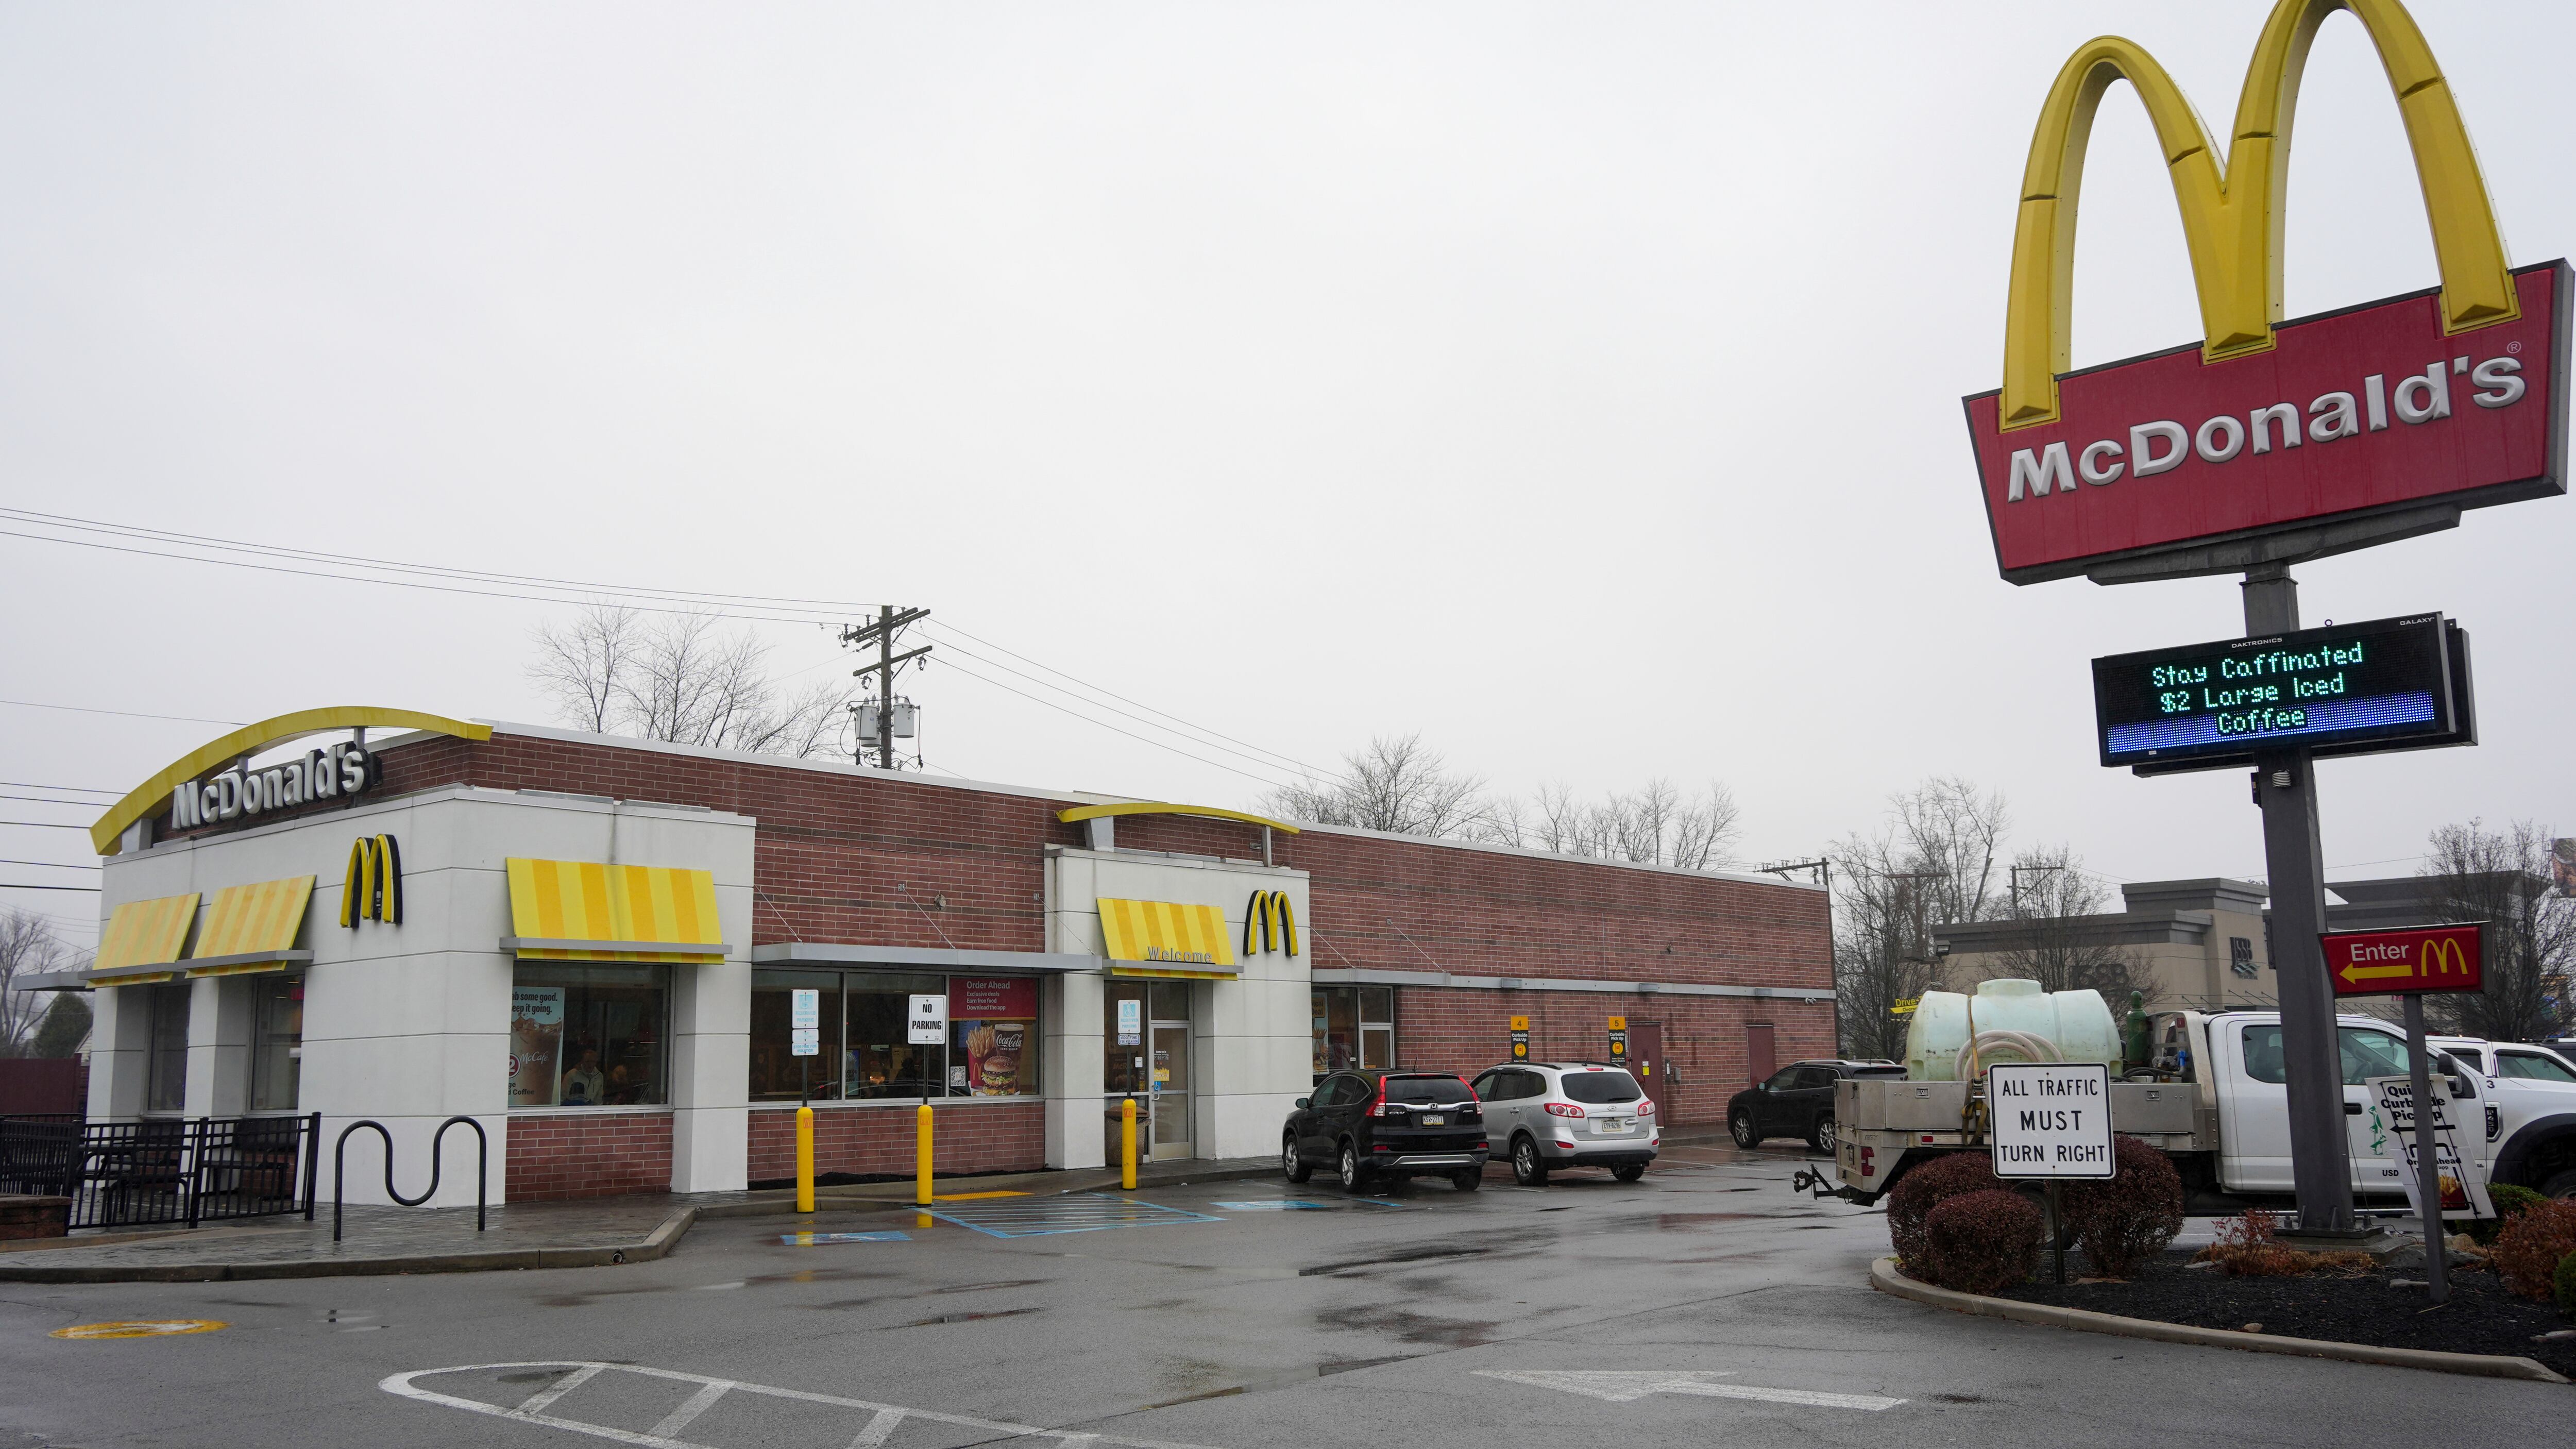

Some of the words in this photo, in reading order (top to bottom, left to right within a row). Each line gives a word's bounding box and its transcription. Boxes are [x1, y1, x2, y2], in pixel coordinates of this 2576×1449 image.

[2007, 356, 2526, 503] McDonald's
[2399, 617, 2433, 626] GALAXY
[2231, 637, 2283, 648] DAKTRONICS
[2153, 666, 2207, 687] Stay
[2222, 641, 2363, 679] Caffinated
[2160, 690, 2191, 713] $2
[2204, 685, 2279, 708] Large
[2293, 671, 2345, 698] Iced
[2218, 707, 2306, 733] Coffee
[172, 743, 366, 830] McDonald's
[1147, 946, 1213, 964] Welcome
[2350, 942, 2410, 962] Enter
[988, 981, 1010, 989] Ahead
[539, 992, 558, 1003] good.
[512, 1005, 524, 1014] eep
[526, 1004, 531, 1012] it
[532, 1004, 552, 1015] going.
[923, 1004, 933, 1013] NO
[912, 1020, 942, 1030] PARKING
[2003, 1080, 2029, 1097] ALL
[2038, 1079, 2098, 1096] TRAFFIC
[2387, 1085, 2412, 1097] Qui
[2486, 1080, 2495, 1089] 3
[2381, 1098, 2446, 1109] Curbde
[2020, 1110, 2082, 1131] MUST
[2001, 1145, 2045, 1162] TURN
[2057, 1145, 2105, 1162] RIGHT
